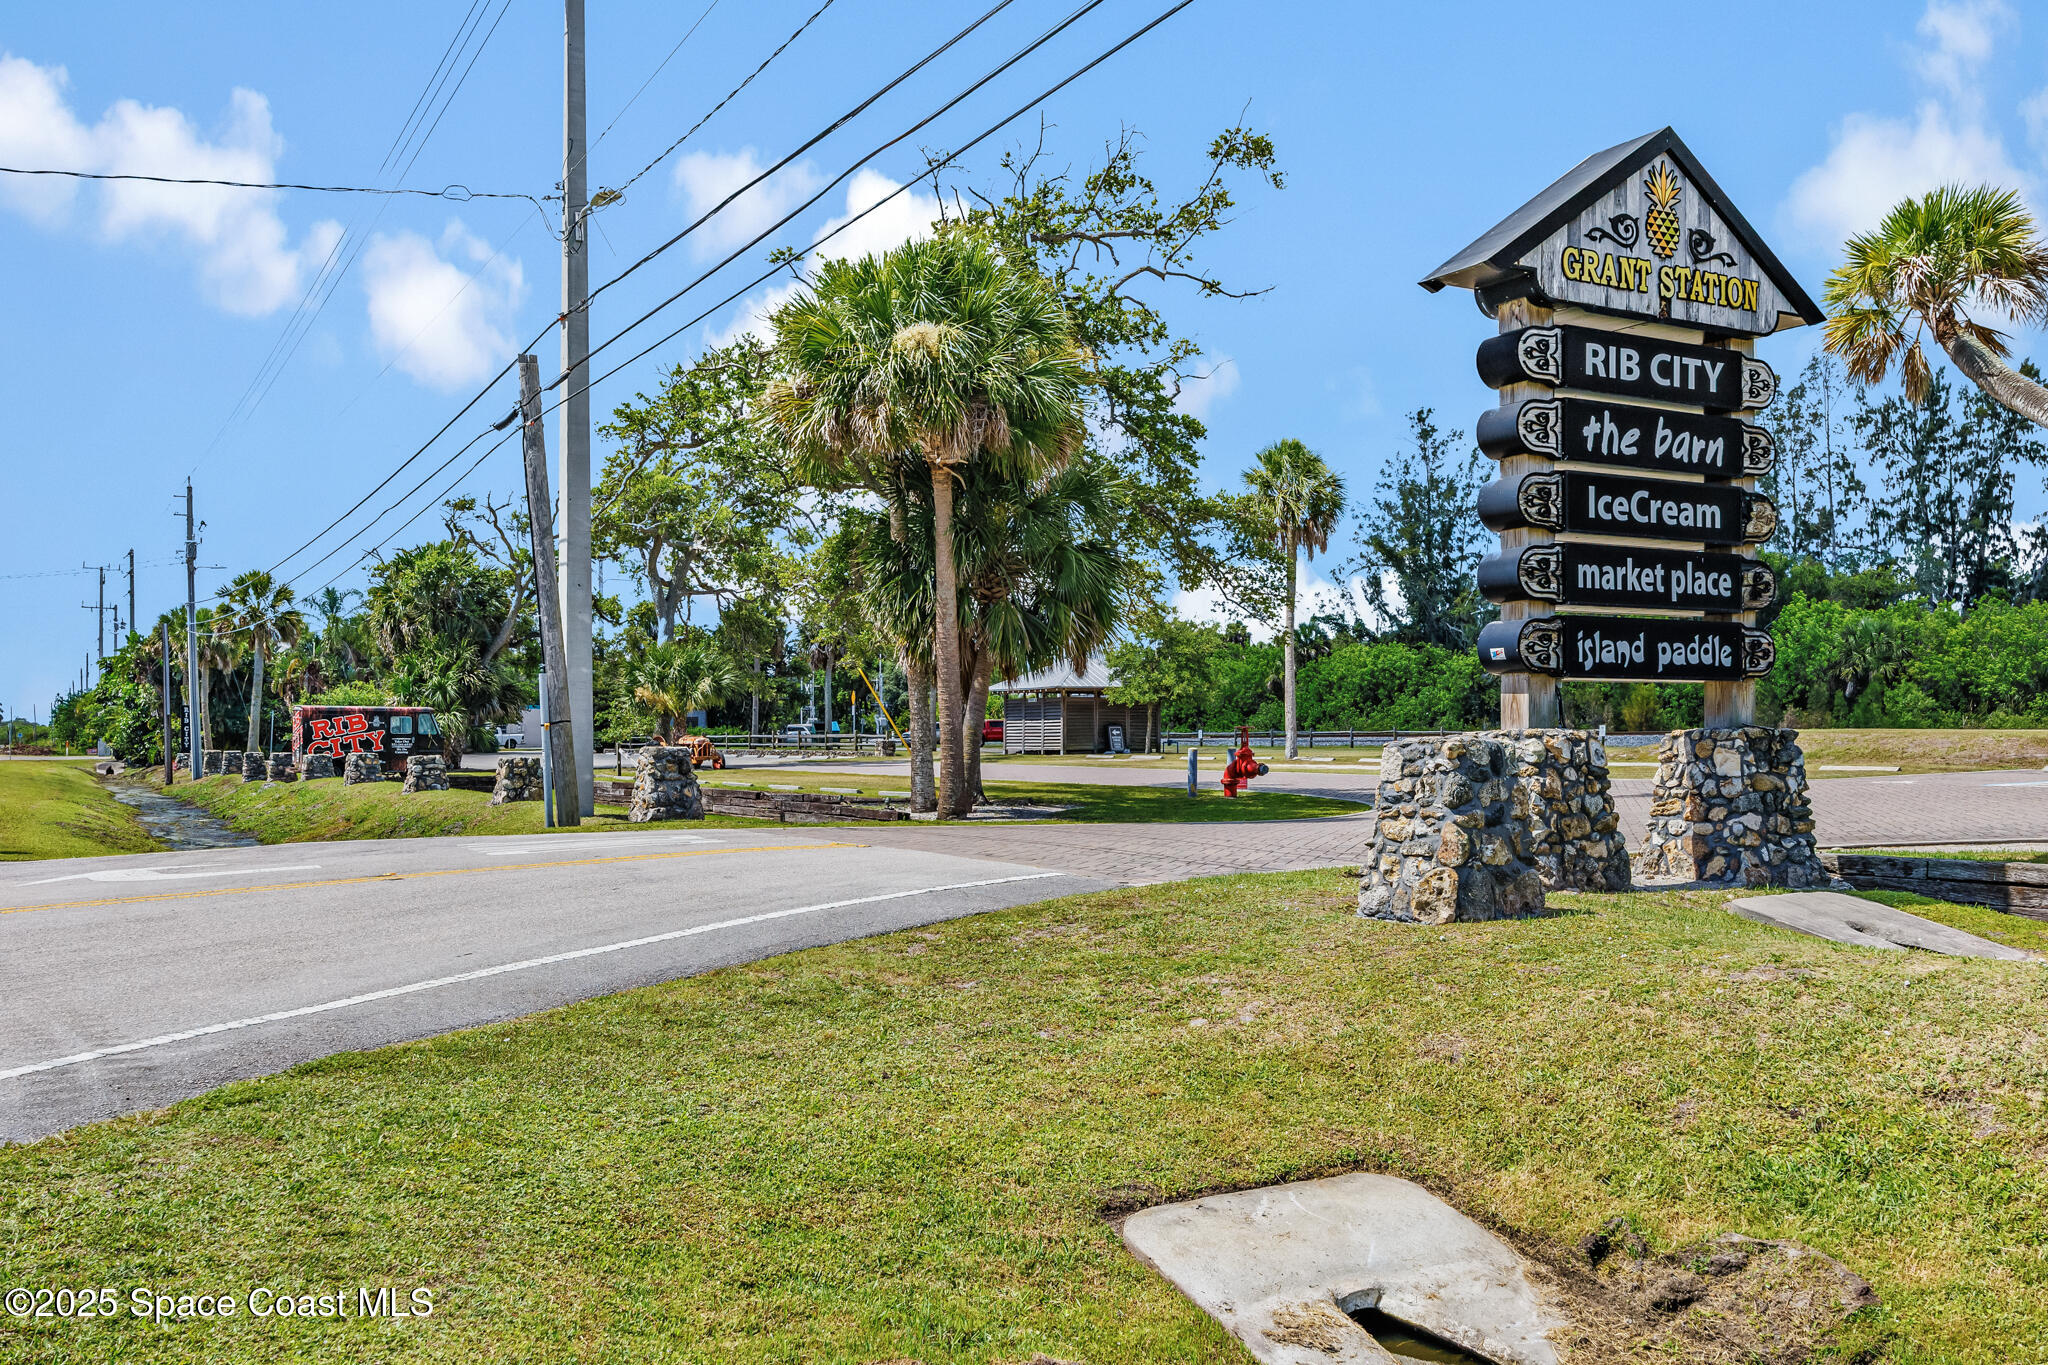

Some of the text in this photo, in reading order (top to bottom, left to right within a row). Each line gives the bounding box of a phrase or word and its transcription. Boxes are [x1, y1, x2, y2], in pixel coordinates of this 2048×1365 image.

[1562, 246, 1759, 312] GRANT STATION
[1585, 342, 1725, 393] RIB CITY
[1583, 410, 1724, 467] the barn
[1588, 485, 1721, 529] IceCream
[1577, 557, 1732, 602] market place
[1577, 630, 1732, 673] island paddle
[307, 730, 385, 758] CITY
[310, 713, 369, 740] RIB
